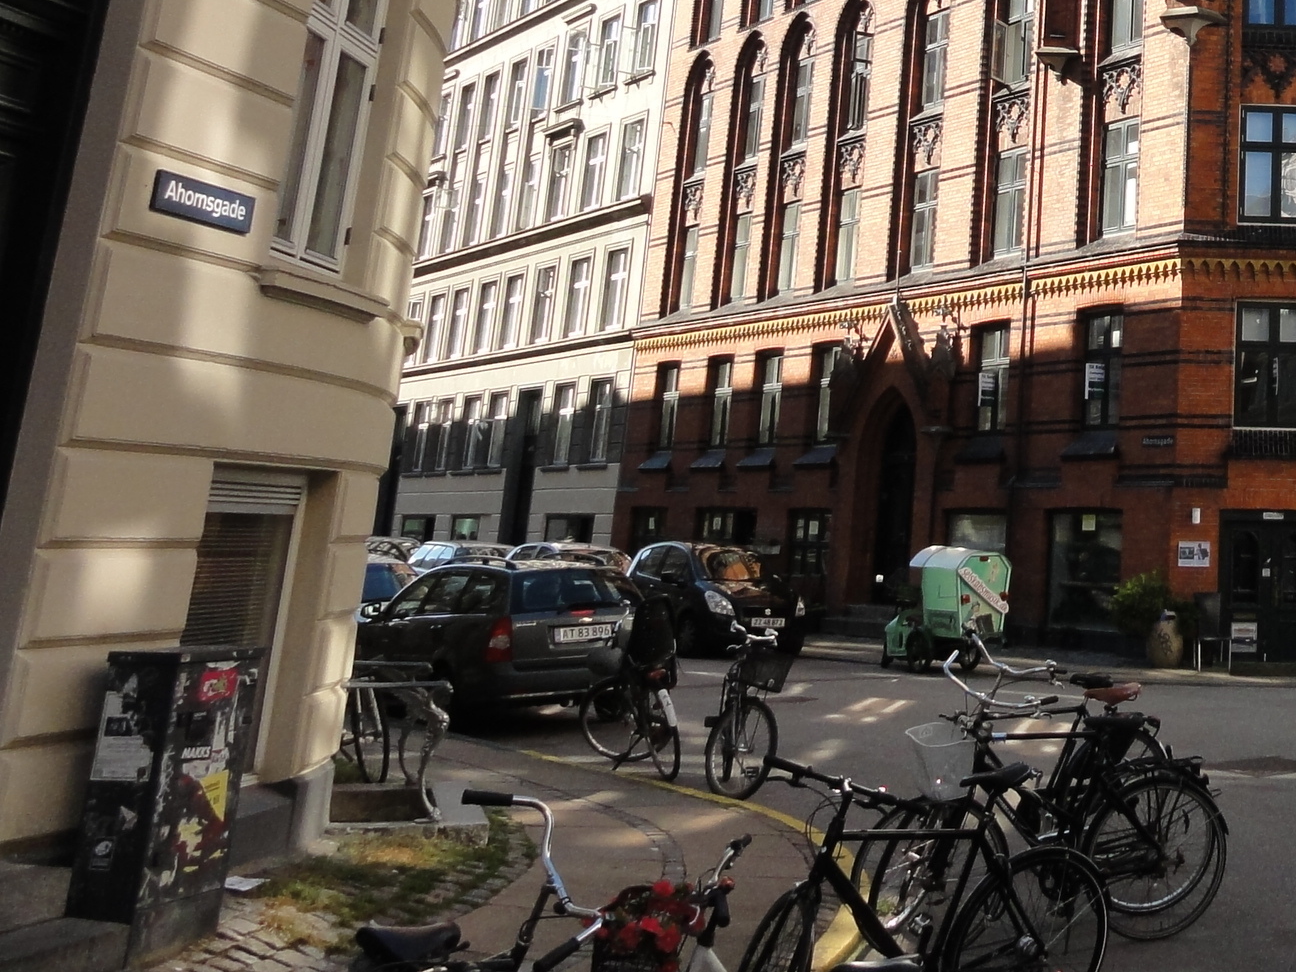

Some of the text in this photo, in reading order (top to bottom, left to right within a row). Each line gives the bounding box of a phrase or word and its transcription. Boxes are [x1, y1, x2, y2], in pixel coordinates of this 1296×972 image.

[164, 180, 246, 220] Ahornsgade
[562, 626, 610, 640] AT 83 896
